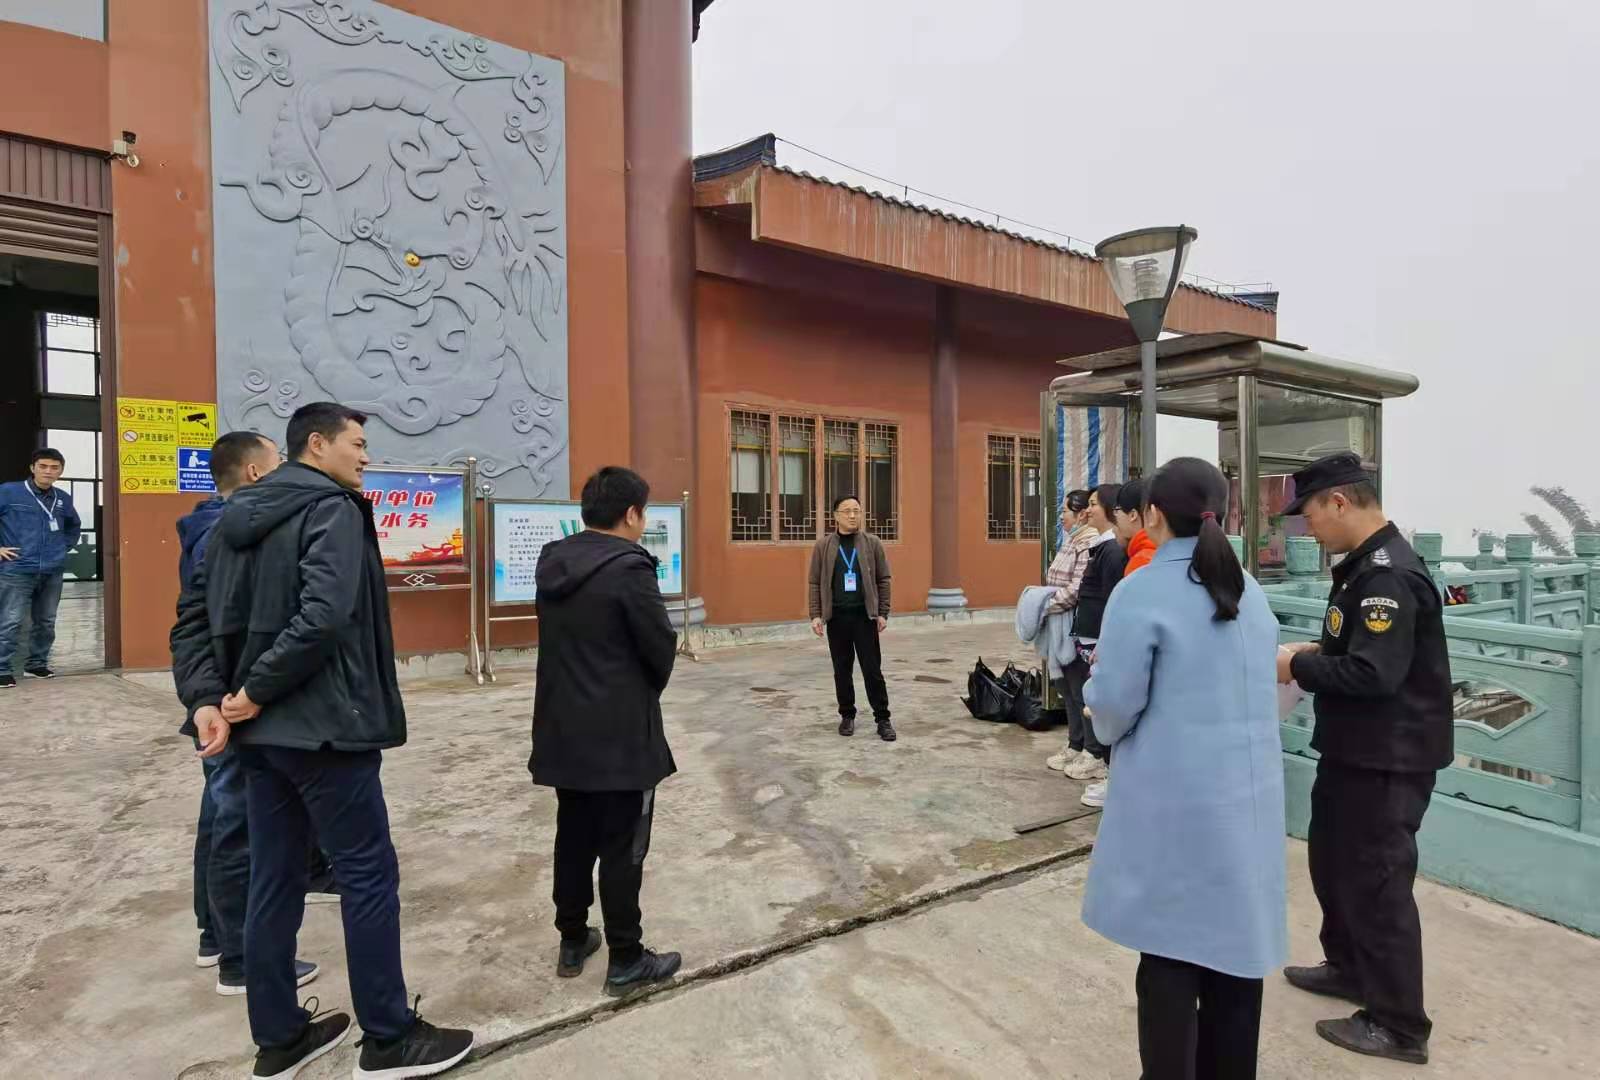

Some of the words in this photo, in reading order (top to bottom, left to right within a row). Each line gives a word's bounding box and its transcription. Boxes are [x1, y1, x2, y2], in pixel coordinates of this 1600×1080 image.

[136, 406, 174, 415] 工作重地
[138, 414, 174, 422] 禁止入内
[139, 454, 175, 462] 注意安全
[143, 478, 176, 486] 禁止吸烟
[374, 511, 430, 528] 水务
